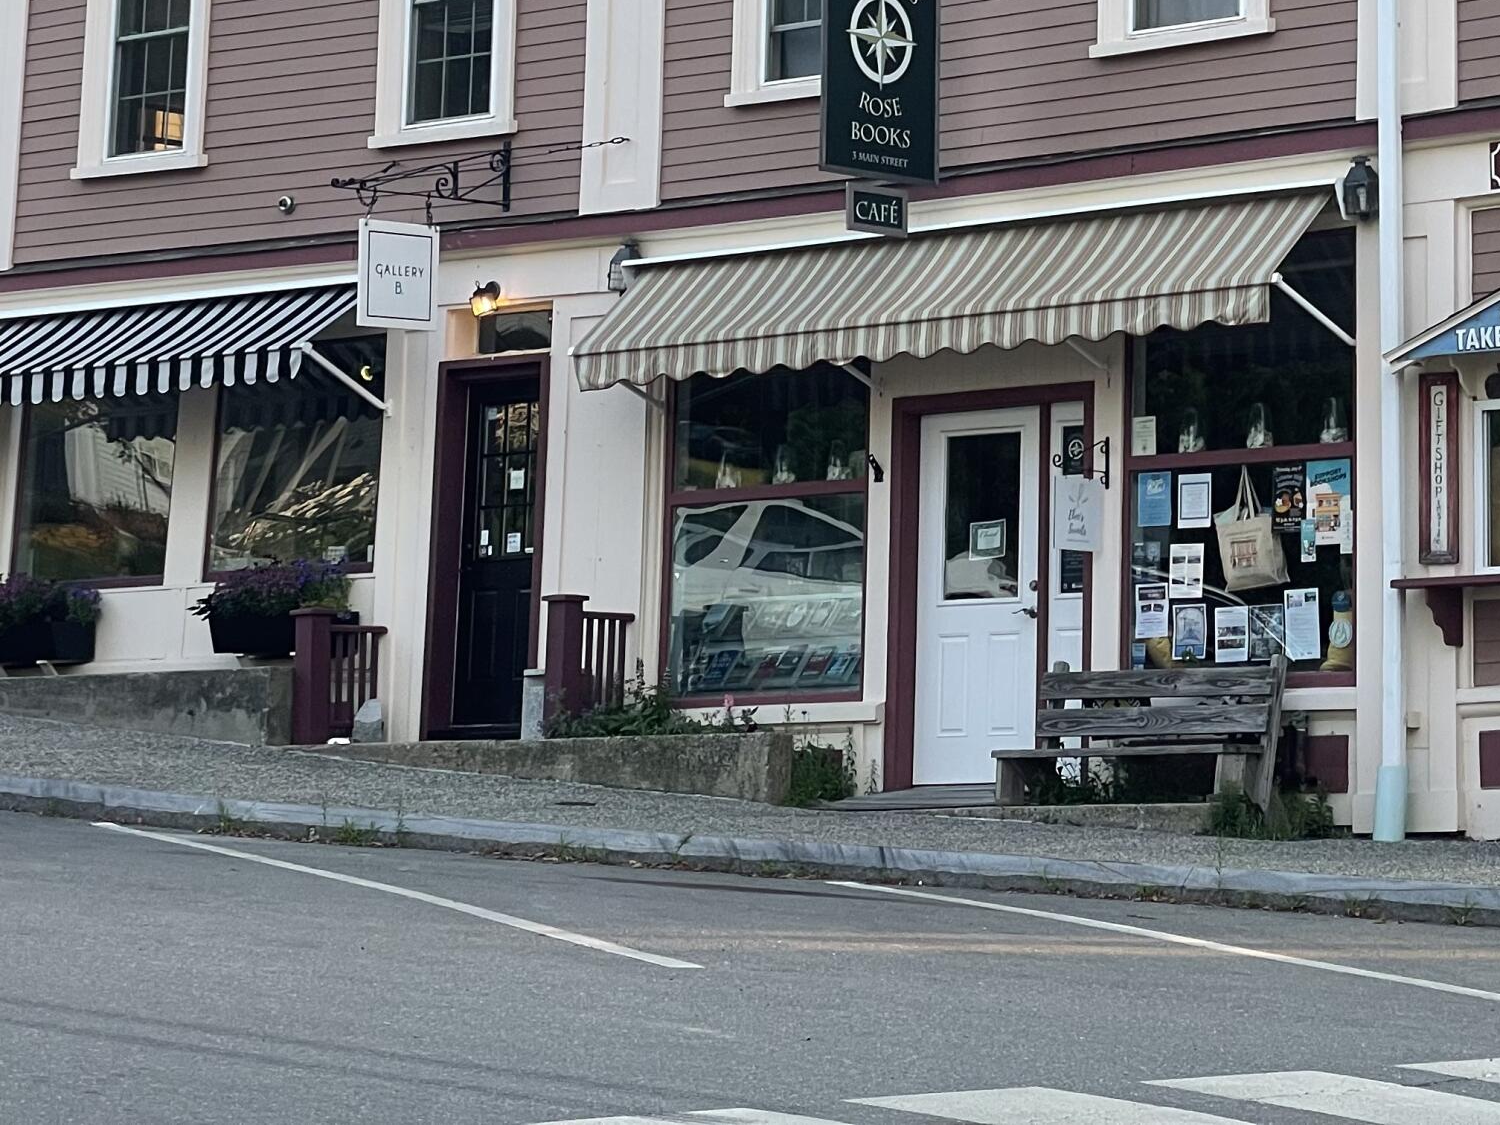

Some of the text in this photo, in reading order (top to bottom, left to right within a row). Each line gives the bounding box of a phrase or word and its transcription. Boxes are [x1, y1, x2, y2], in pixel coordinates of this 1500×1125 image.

[858, 91, 902, 118] ROSE
[851, 121, 911, 149] BOOKS
[857, 152, 880, 165] MAIN
[880, 156, 909, 168] STREET
[855, 199, 899, 225] CAFÉ
[375, 263, 425, 278] GALLERY
[1433, 390, 1444, 445] GIFT
[1434, 447, 1444, 498] SHOP
